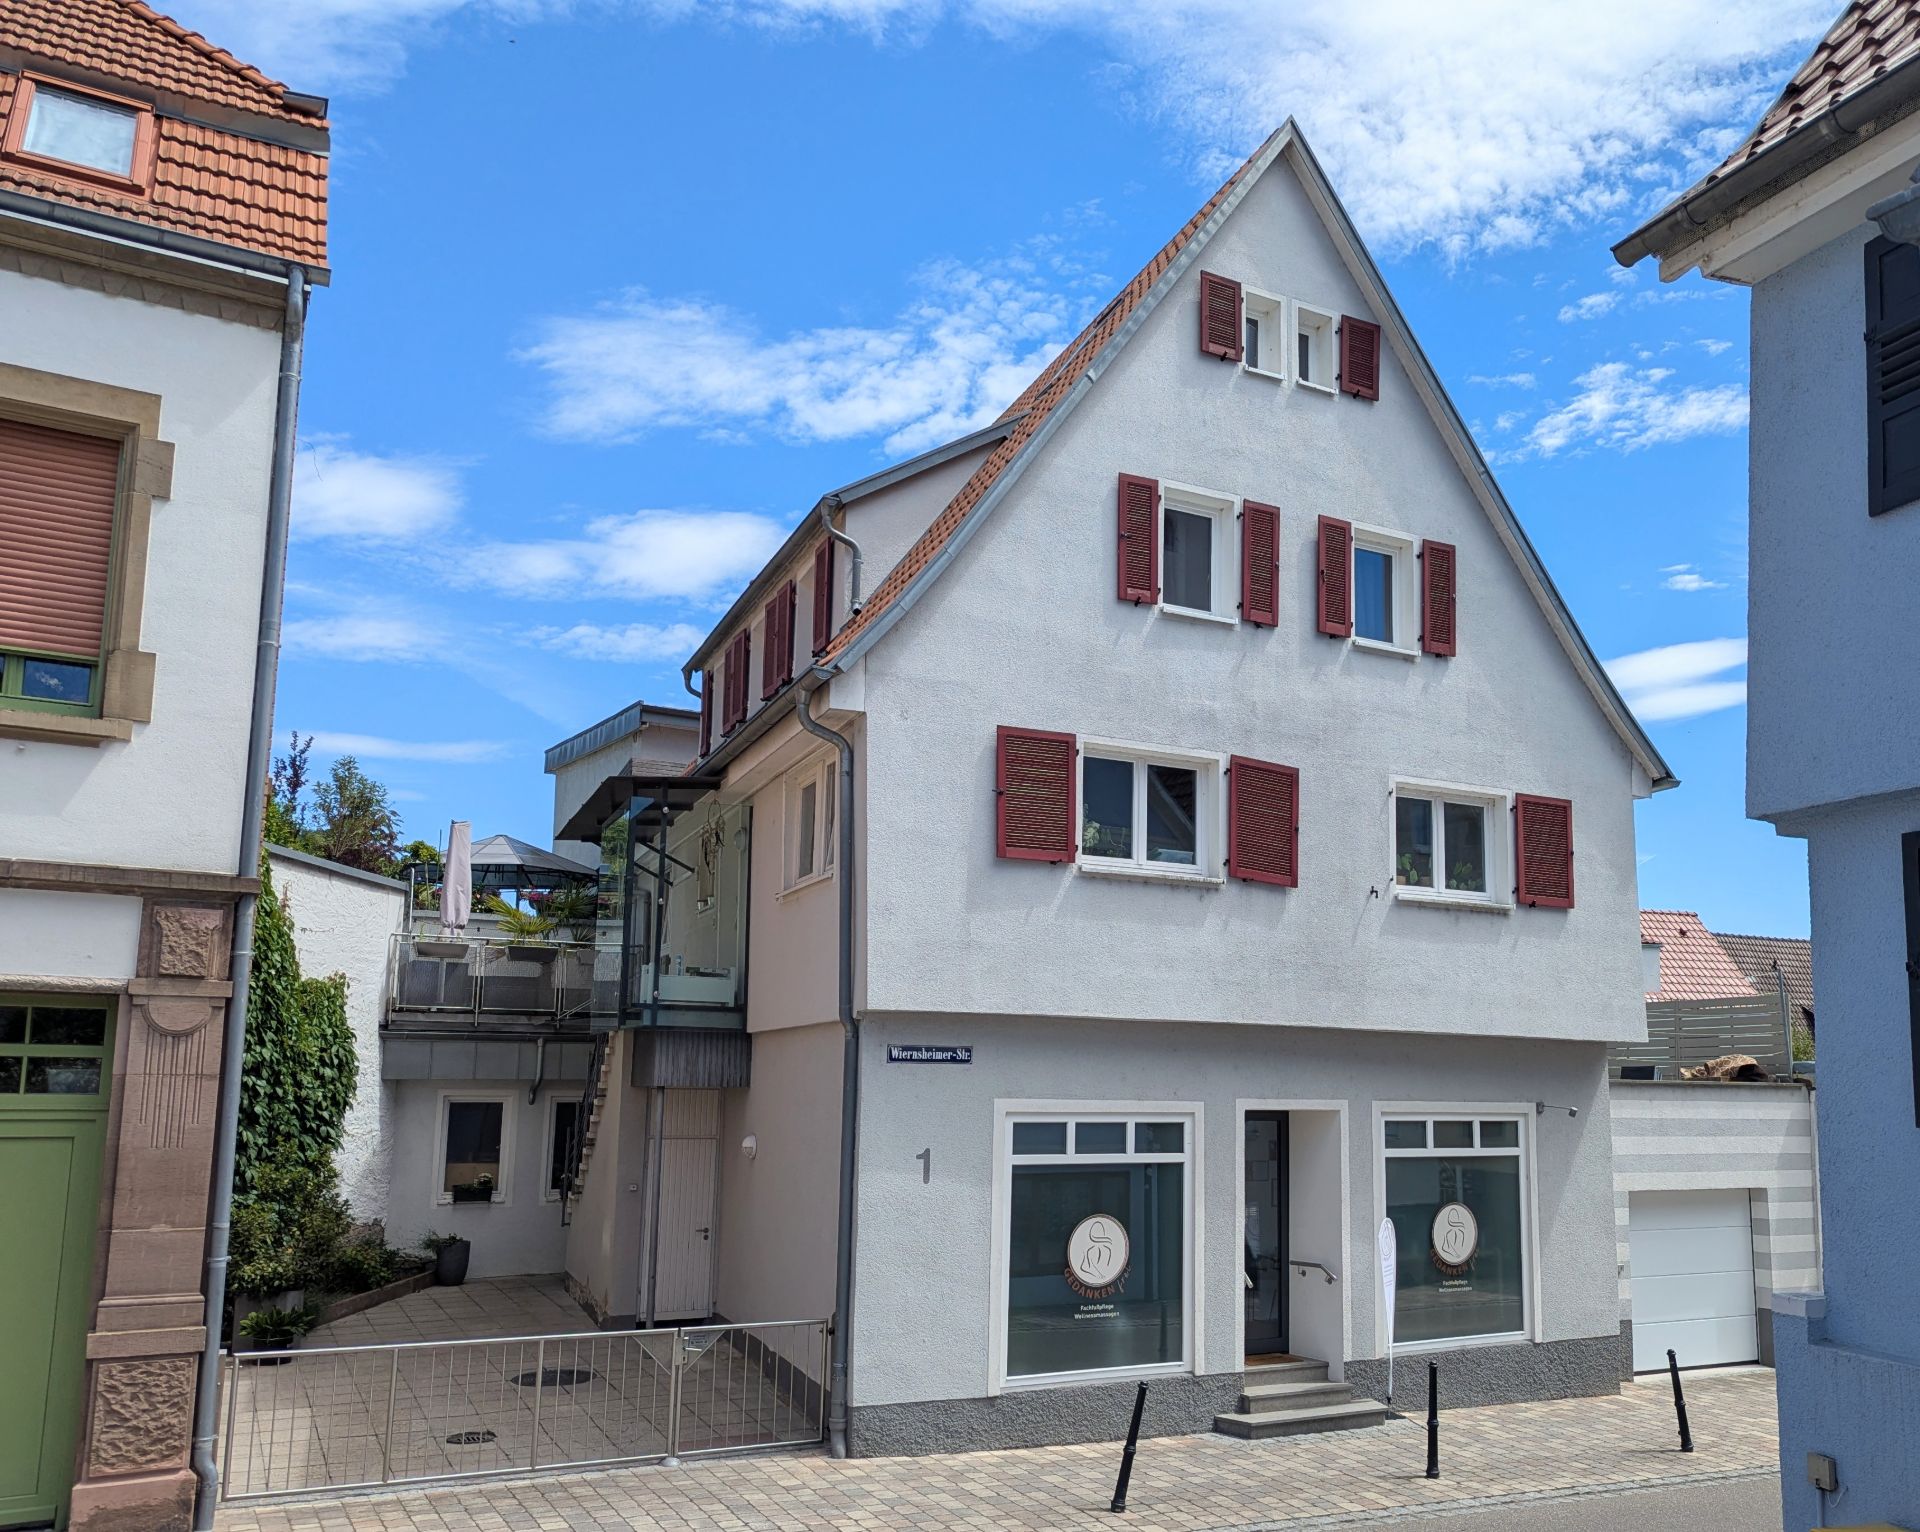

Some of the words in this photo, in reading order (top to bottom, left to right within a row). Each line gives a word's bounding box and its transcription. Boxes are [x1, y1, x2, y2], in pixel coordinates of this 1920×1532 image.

[890, 1046, 971, 1060] Wiernsheimer-Str.
[916, 1148, 930, 1184] 1
[1064, 1267, 1116, 1299] GEDANKEN
